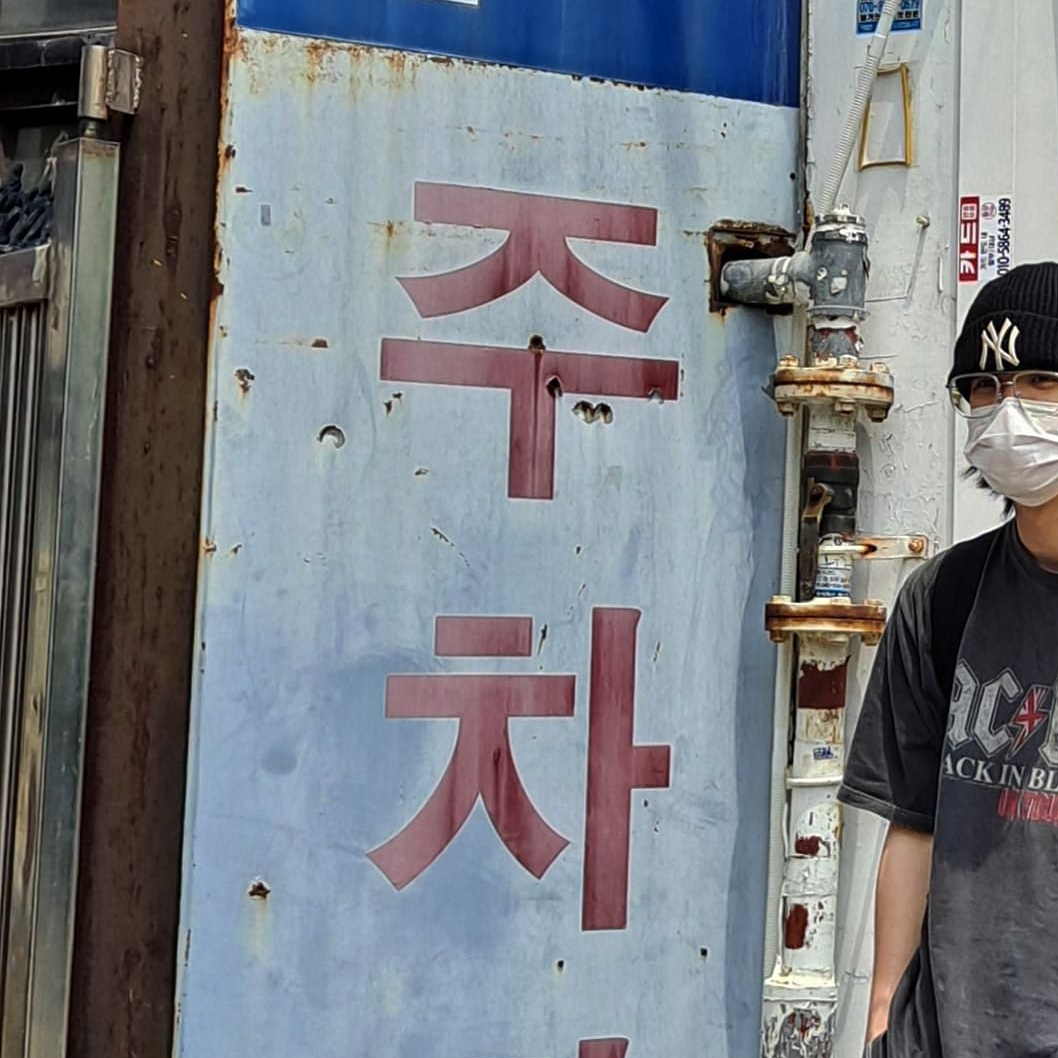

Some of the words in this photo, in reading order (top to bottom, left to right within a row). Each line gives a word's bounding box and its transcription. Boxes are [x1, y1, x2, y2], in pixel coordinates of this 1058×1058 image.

[960, 222, 976, 275] 카드
[979, 316, 1021, 371] NY
[942, 752, 998, 785] ACK
[999, 762, 1026, 789] IN
